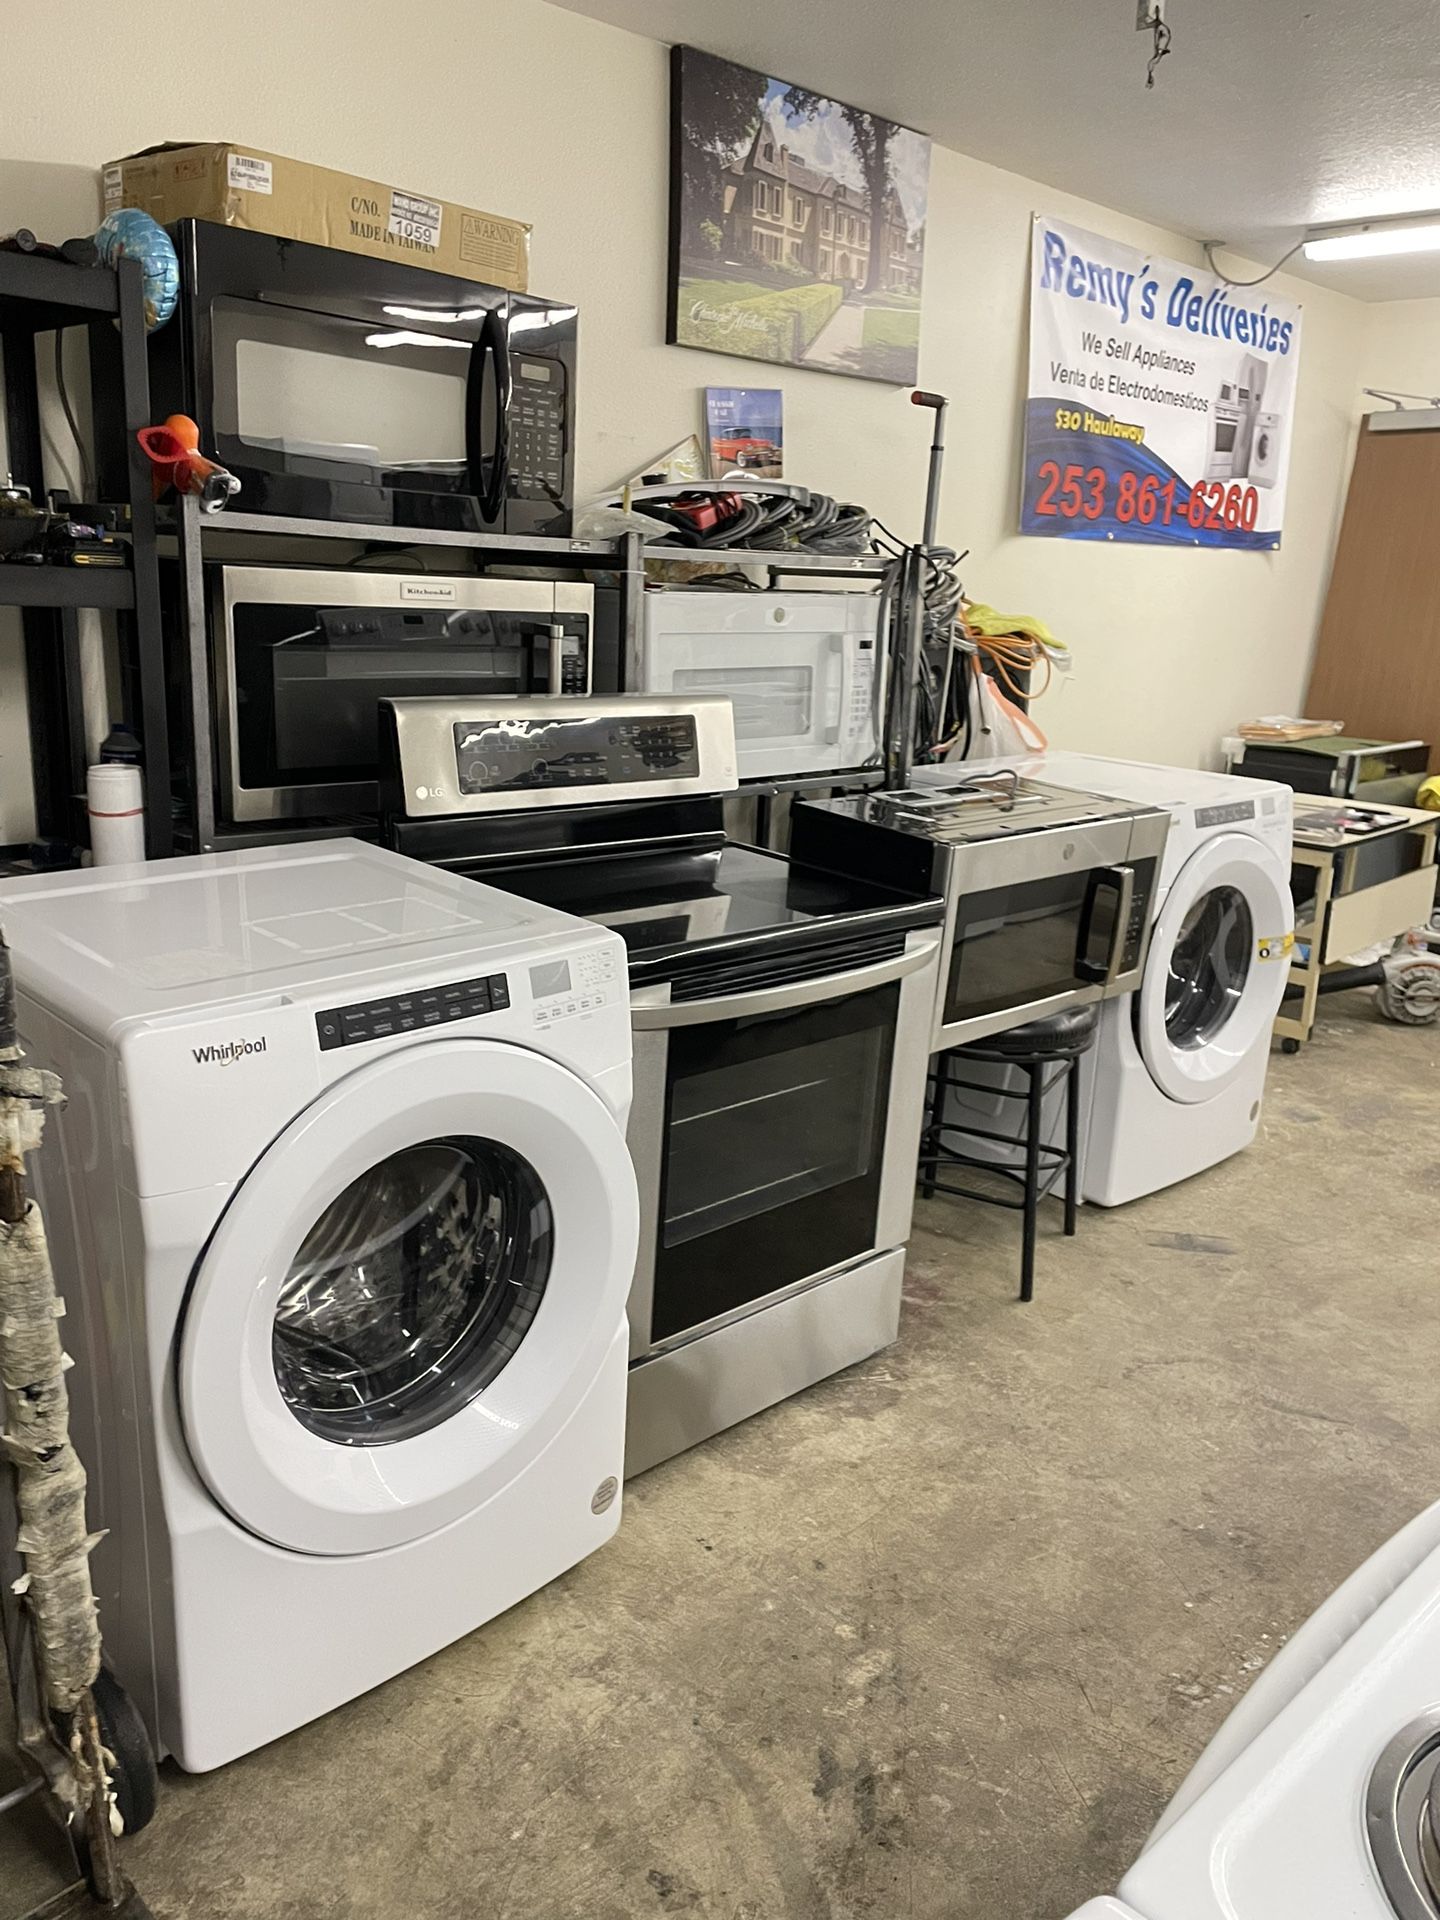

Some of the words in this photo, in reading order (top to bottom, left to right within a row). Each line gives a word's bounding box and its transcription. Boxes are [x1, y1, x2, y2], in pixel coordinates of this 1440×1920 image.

[351, 196, 381, 218] C/NO.
[350, 220, 381, 242] MADE
[383, 228, 395, 245] IN
[396, 220, 432, 242] 1059
[473, 218, 520, 246] WARNING
[1166, 277, 1293, 355] Deliveries
[1082, 331, 1102, 355] We
[1105, 337, 1132, 361] Sell
[1132, 344, 1196, 375] Appliances
[1050, 361, 1086, 387] Venta
[1089, 371, 1105, 391] de
[1108, 375, 1209, 412] Electrodomesticos
[1055, 407, 1082, 431] $30
[1083, 411, 1146, 445] Haulaway
[1035, 459, 1107, 520] 253
[1115, 470, 1259, 533] 861-6260
[192, 1036, 267, 1064] Whirlpool
